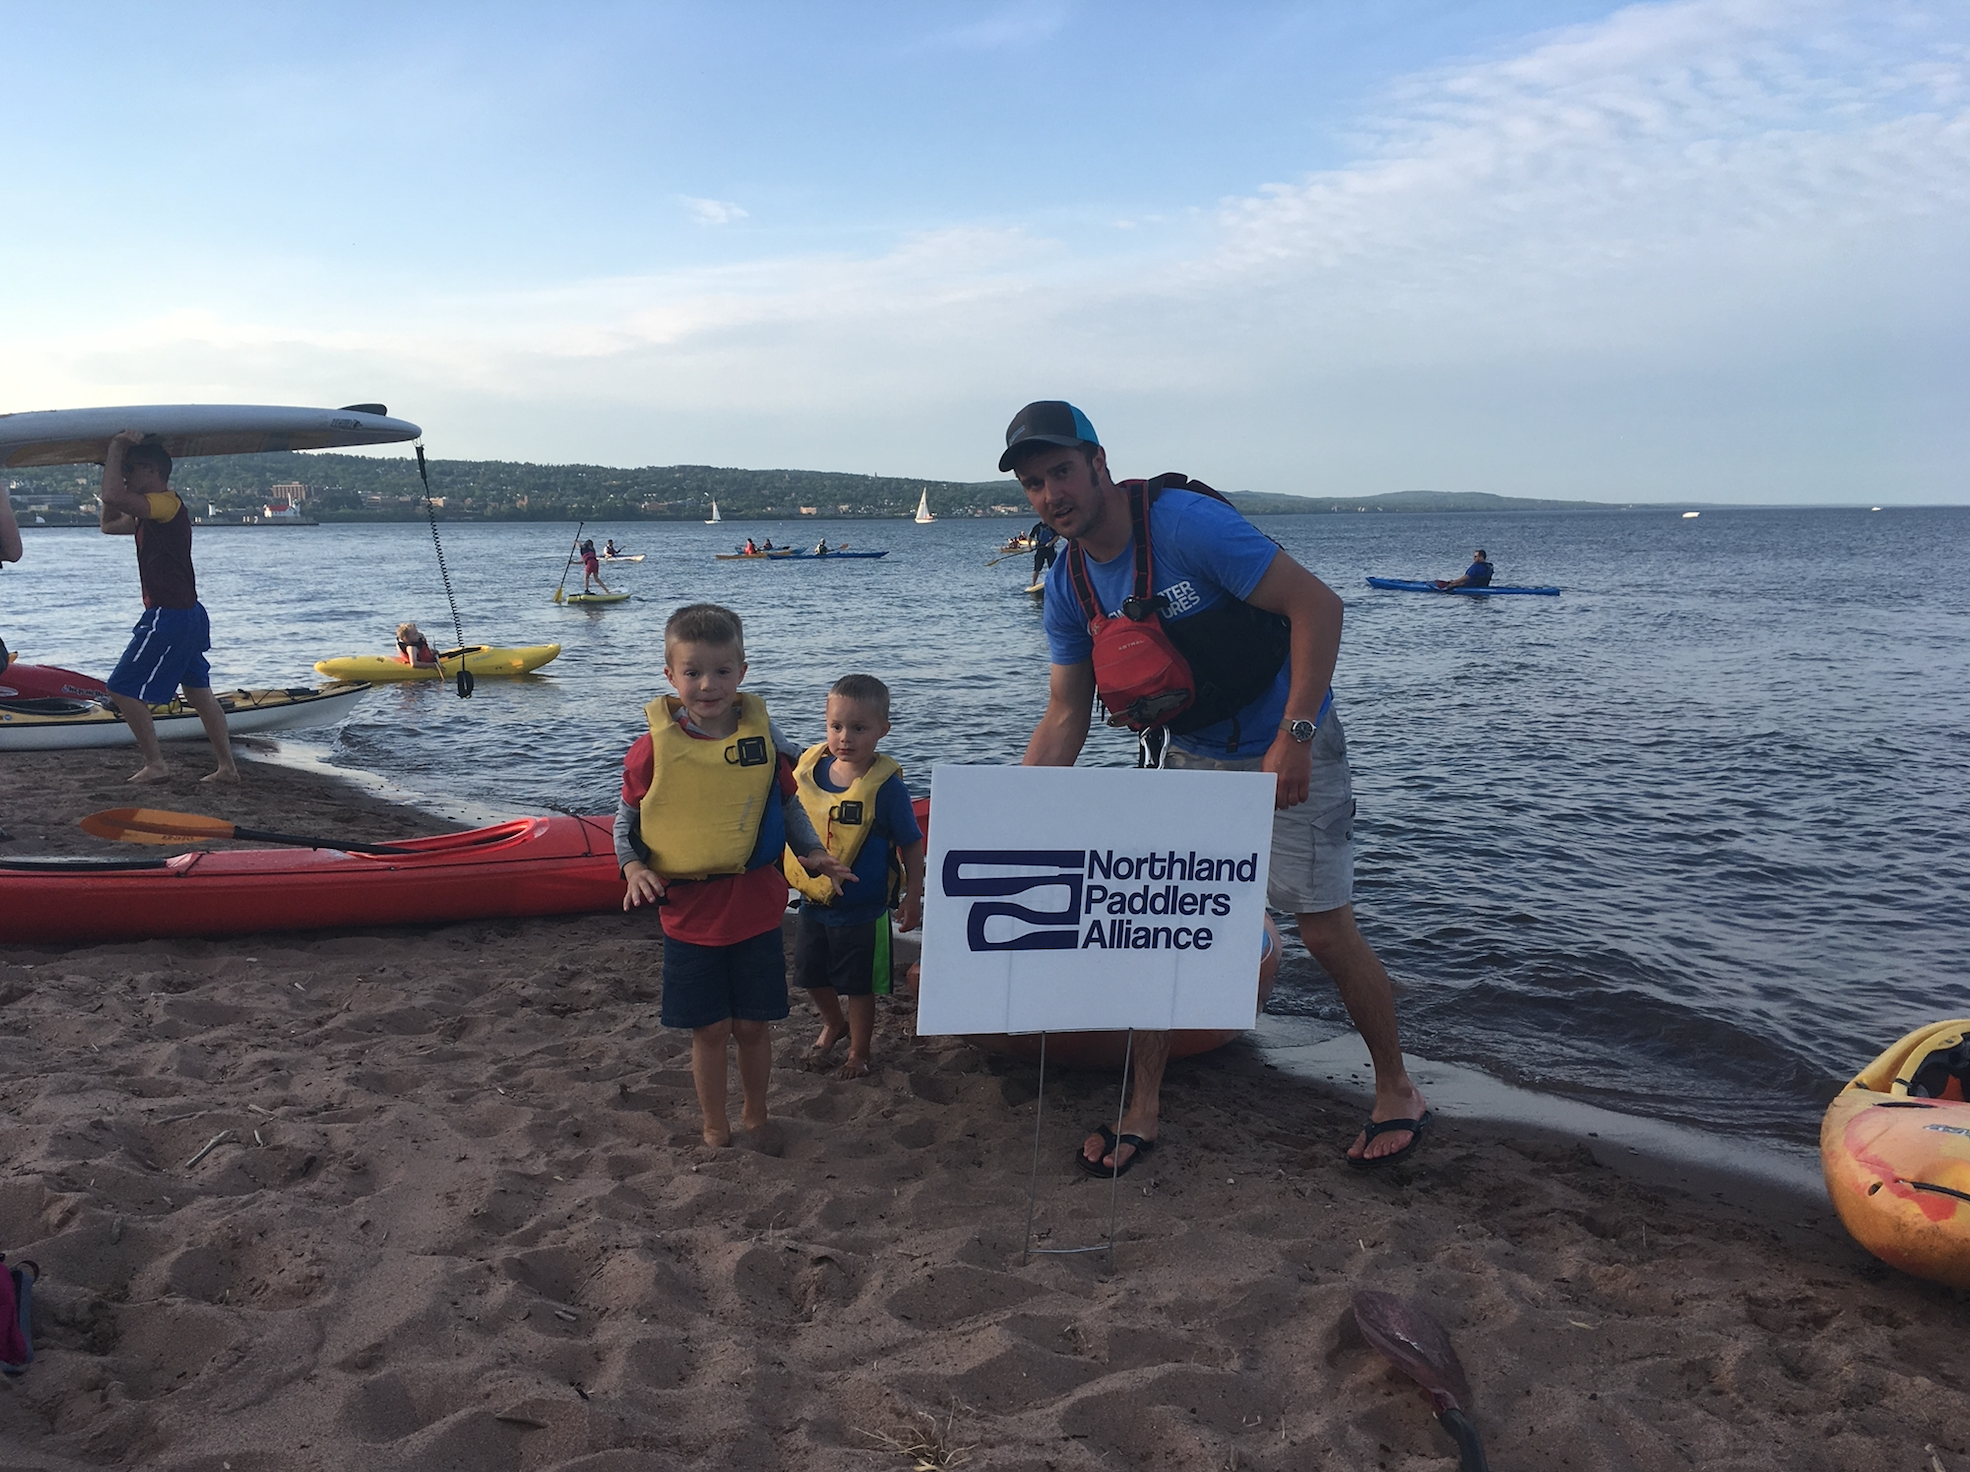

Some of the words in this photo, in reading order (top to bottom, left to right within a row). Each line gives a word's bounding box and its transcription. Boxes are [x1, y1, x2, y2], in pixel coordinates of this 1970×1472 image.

[1118, 640, 1145, 651] ASTRAL
[1087, 850, 1258, 882] Northland
[1085, 885, 1231, 915] Paddlers
[1081, 919, 1213, 949] Alliance
